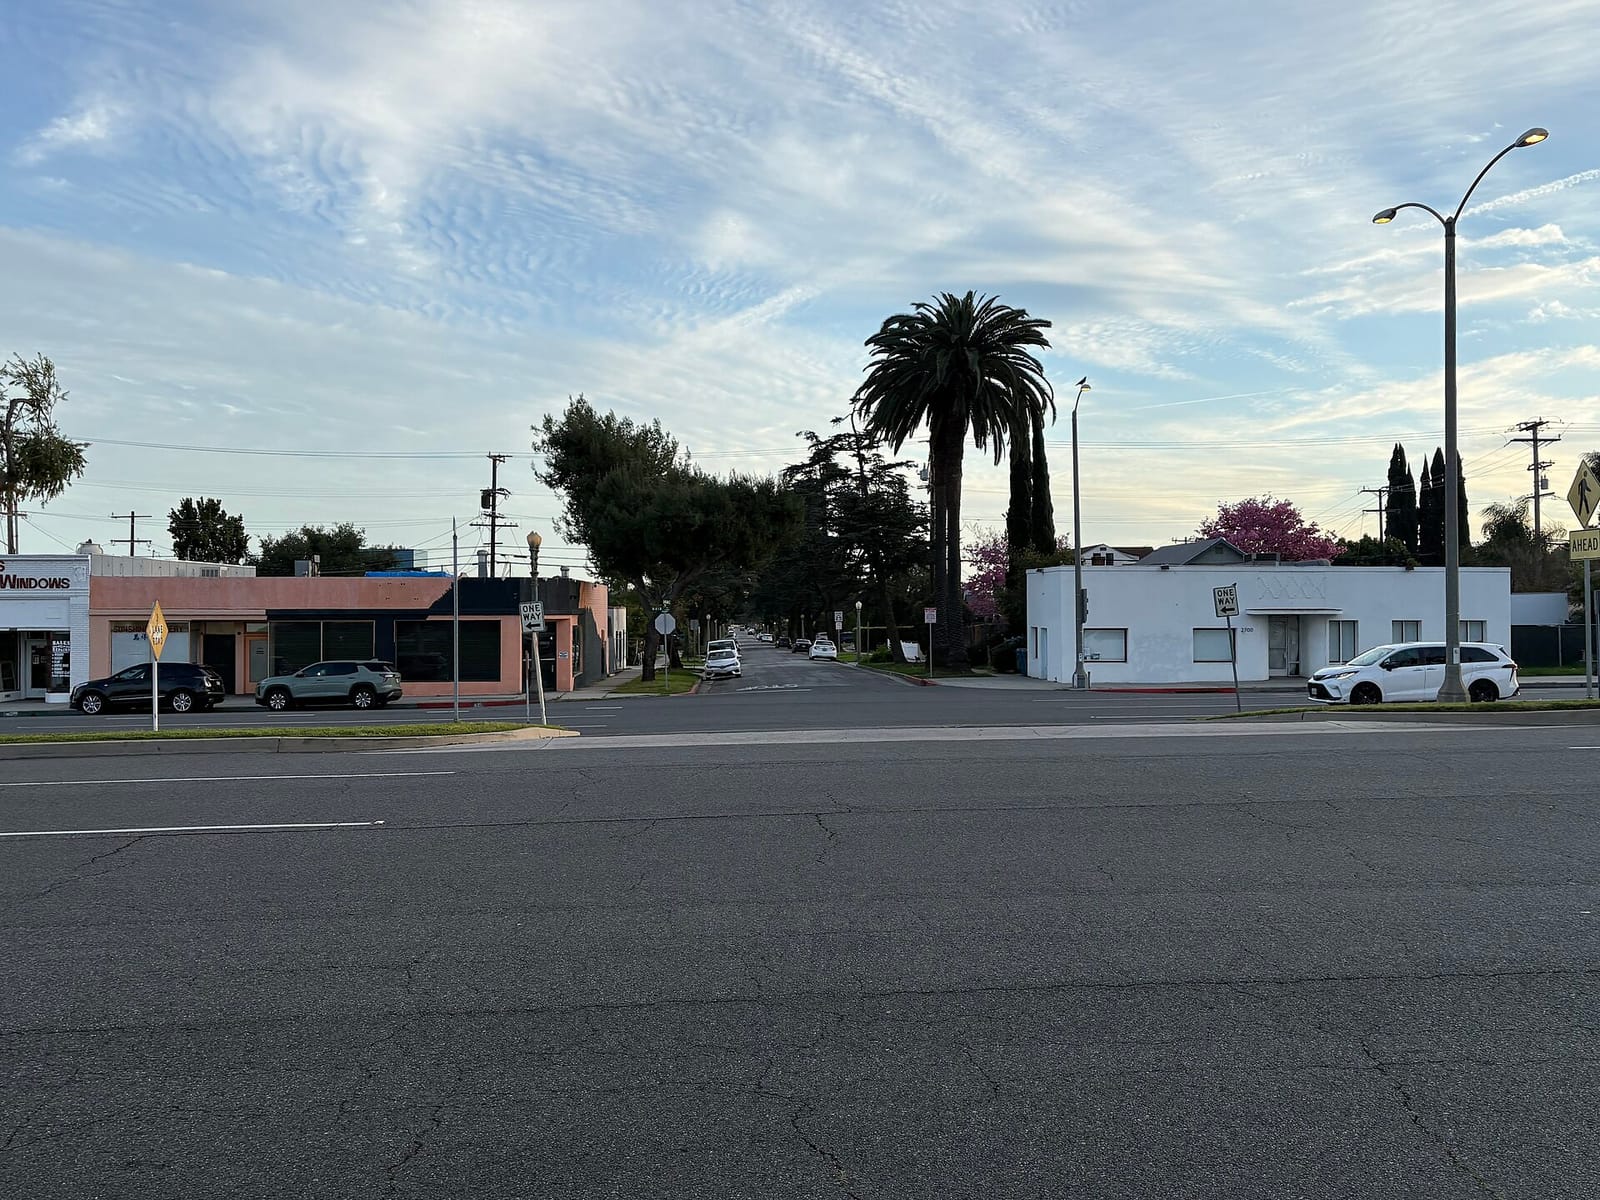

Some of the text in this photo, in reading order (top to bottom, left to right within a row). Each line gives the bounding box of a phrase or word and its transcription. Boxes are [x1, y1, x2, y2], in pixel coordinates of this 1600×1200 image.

[1572, 537, 1599, 552] AHEAD
[1217, 589, 1235, 597] ONE
[1218, 597, 1235, 605] WAY
[522, 604, 541, 612] ONE
[523, 612, 541, 621] WAY
